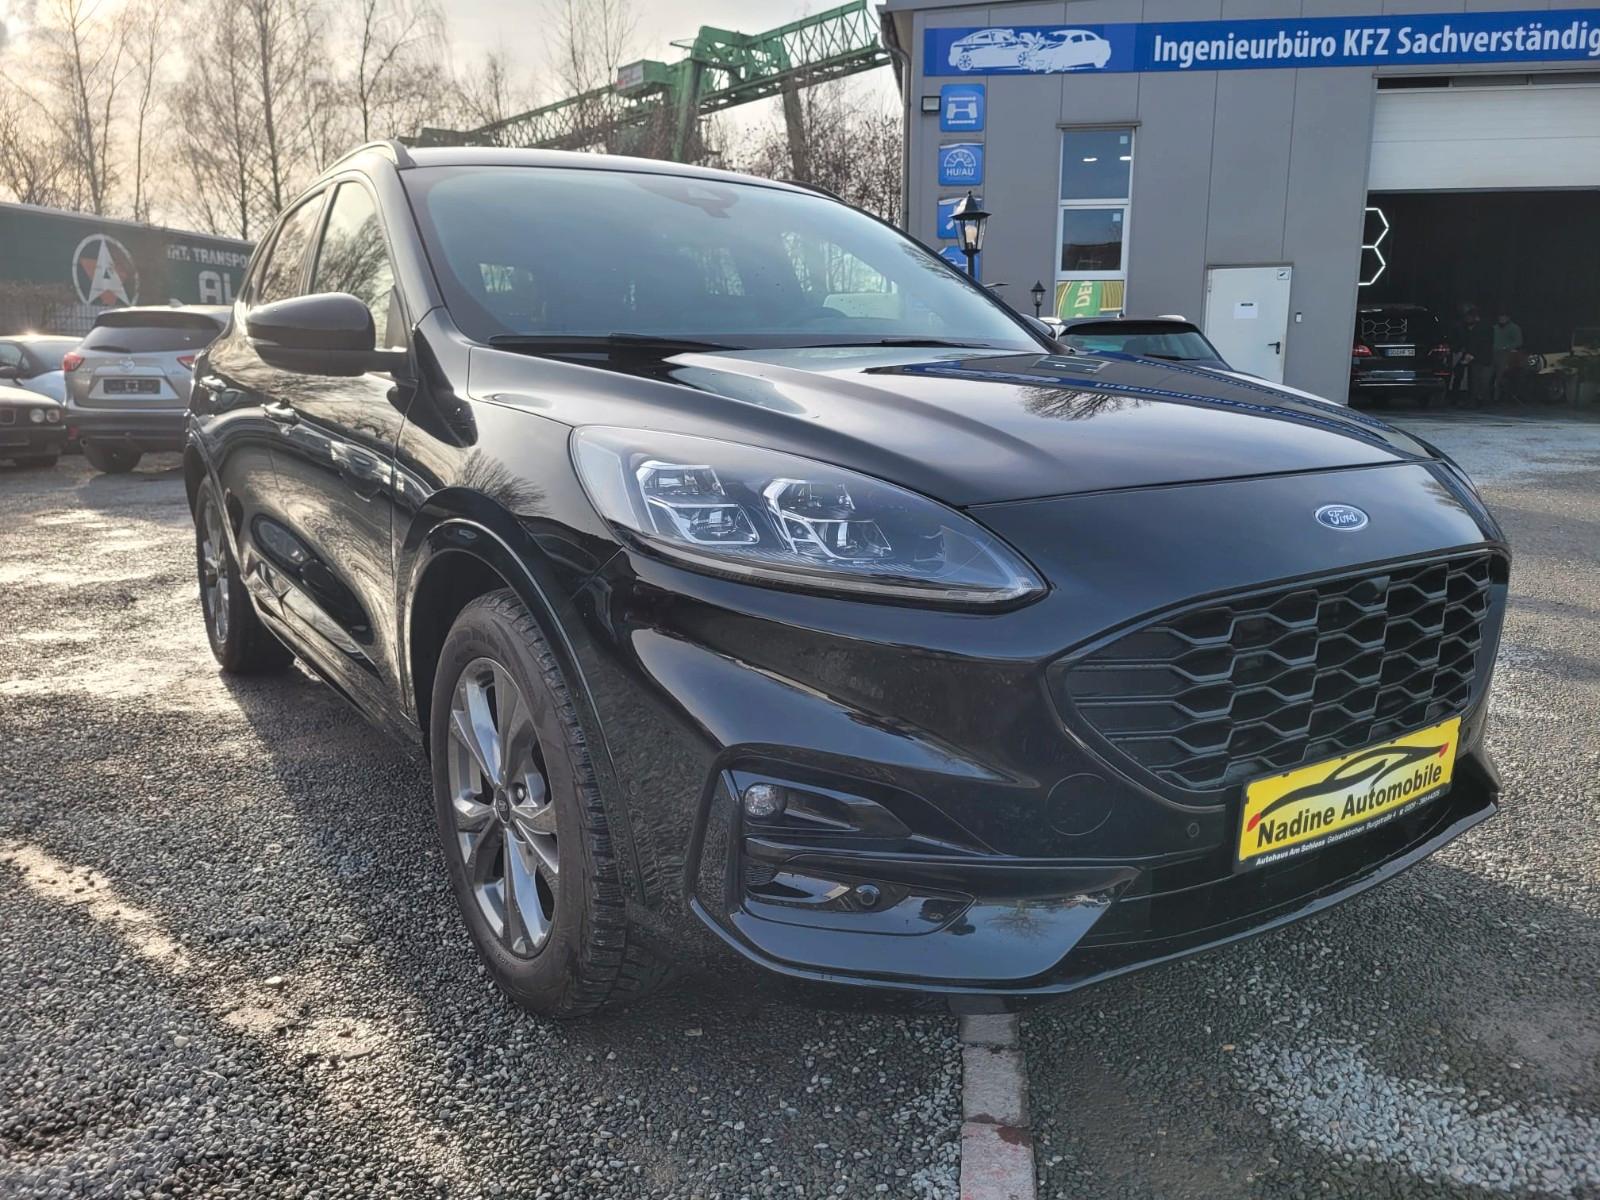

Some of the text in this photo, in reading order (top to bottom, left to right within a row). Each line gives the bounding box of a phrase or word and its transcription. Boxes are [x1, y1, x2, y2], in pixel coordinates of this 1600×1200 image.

[1154, 21, 1600, 69] Ingenieurbüro KFZ Sachverständig
[946, 167, 975, 177] HU/AU
[193, 247, 250, 269] TRANSPO
[1327, 509, 1358, 525] Ford
[1257, 807, 1336, 848] Nadine
[1341, 762, 1442, 820] Automobile
[1255, 850, 1289, 866] Autohaus
[1289, 847, 1300, 857] Am
